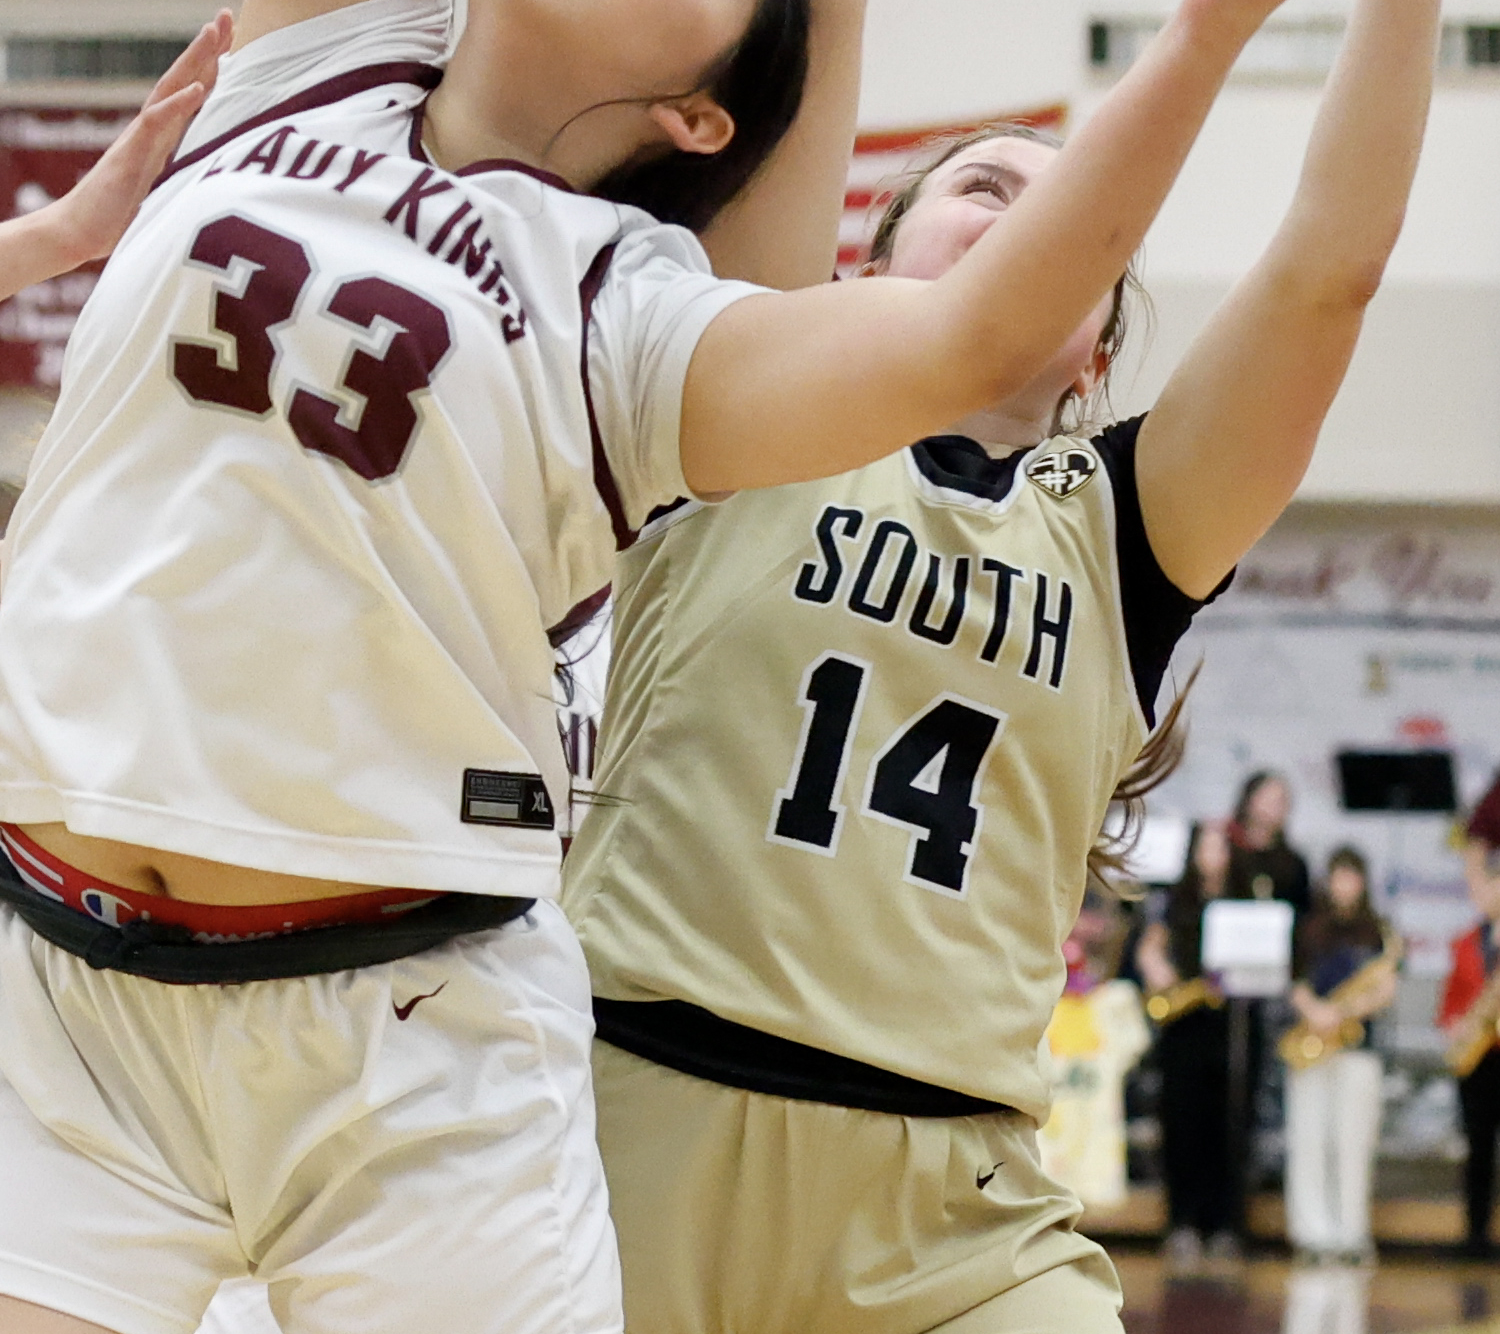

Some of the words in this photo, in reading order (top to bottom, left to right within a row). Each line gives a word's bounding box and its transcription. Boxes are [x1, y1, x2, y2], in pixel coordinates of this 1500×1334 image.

[168, 209, 458, 489] 33
[793, 505, 1074, 691] SOUTH
[531, 791, 549, 813] XL
[769, 652, 1006, 897] 14
